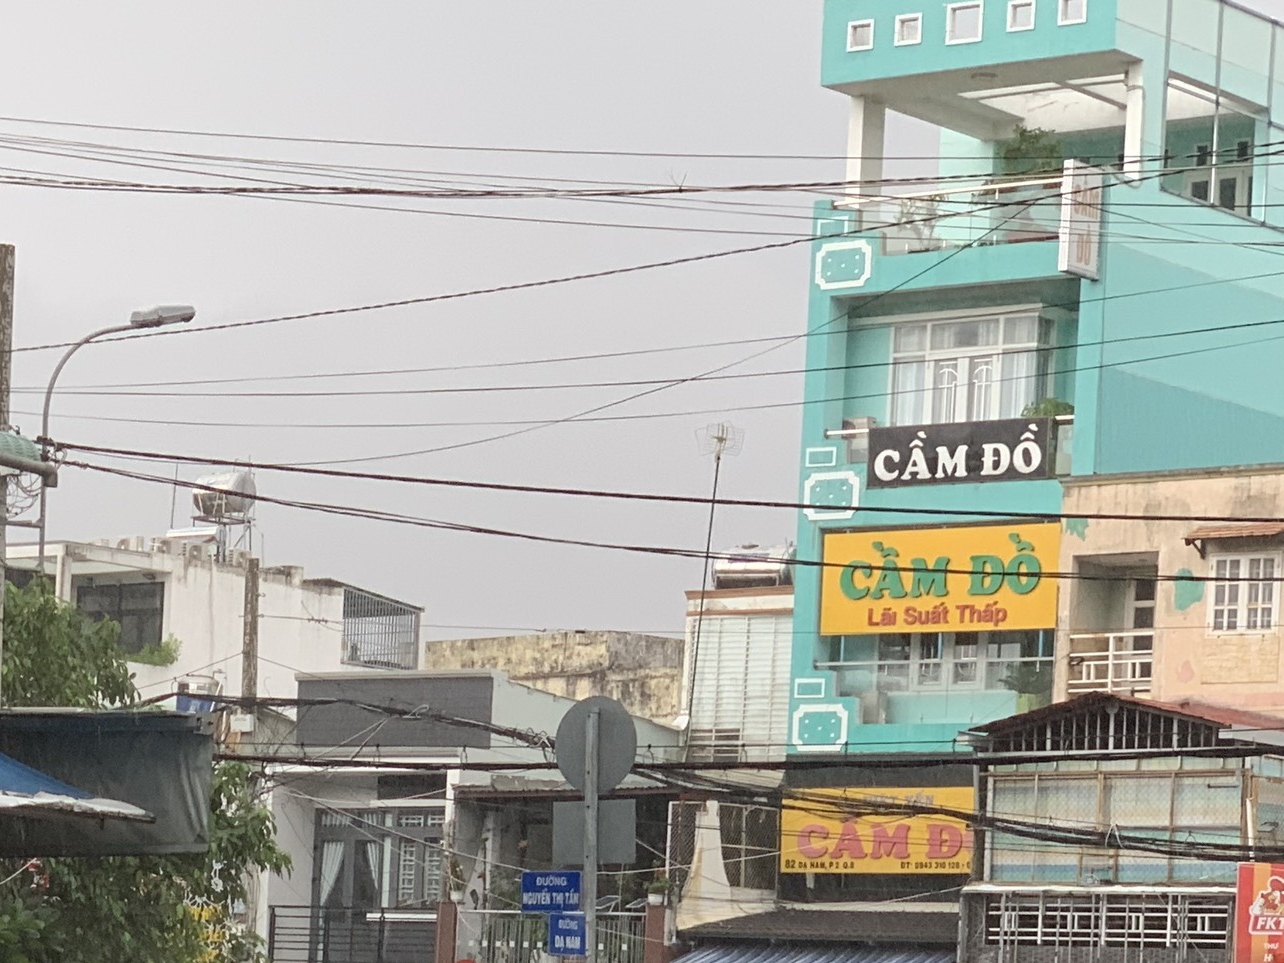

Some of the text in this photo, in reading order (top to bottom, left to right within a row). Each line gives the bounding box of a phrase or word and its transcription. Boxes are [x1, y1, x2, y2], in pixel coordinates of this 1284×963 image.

[873, 423, 1043, 481] CẦM ĐỒ
[839, 532, 1043, 600] CẦM ĐỒ
[867, 600, 1008, 628] Lãi Suất Thấp
[784, 859, 796, 869] 82
[536, 875, 568, 887] ĐƯỜNG
